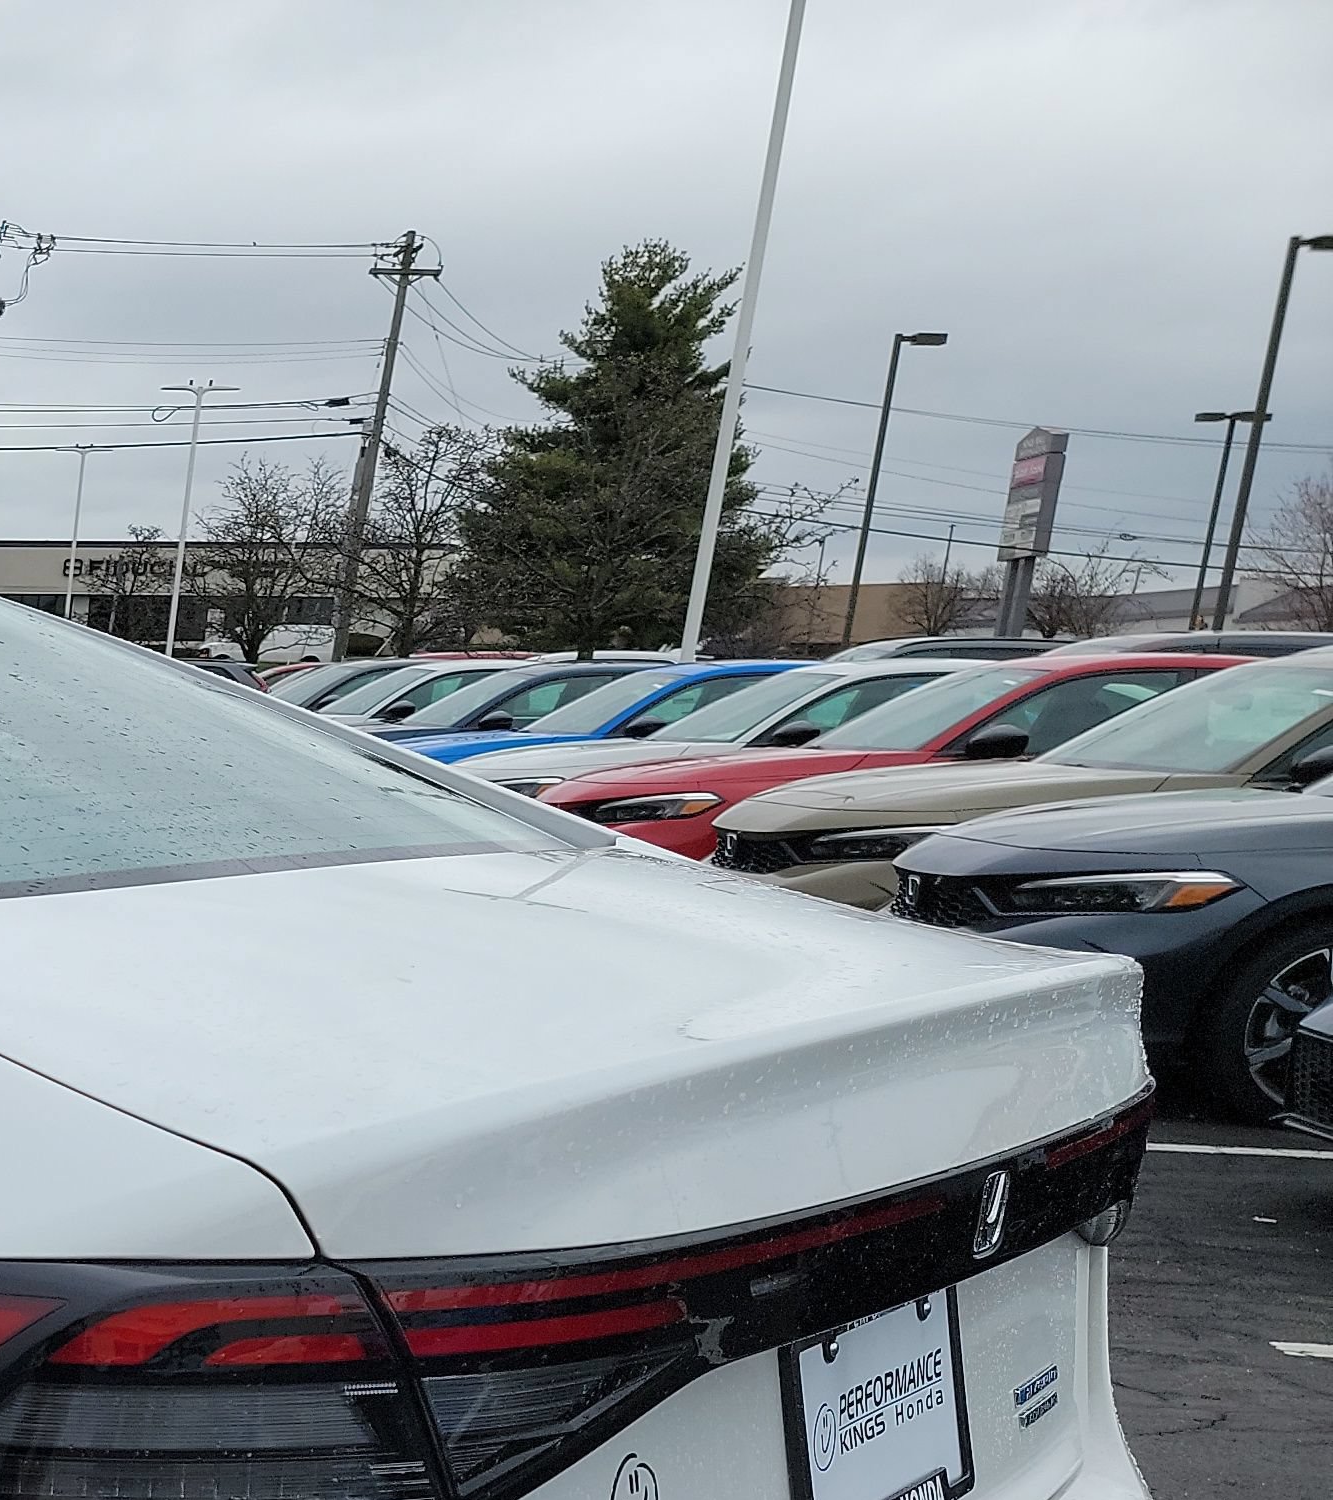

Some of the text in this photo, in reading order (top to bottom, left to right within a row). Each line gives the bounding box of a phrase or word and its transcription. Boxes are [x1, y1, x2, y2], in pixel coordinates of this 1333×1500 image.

[838, 1347, 942, 1427] PERFORMANCE
[839, 1389, 944, 1455] KINGS Honda
